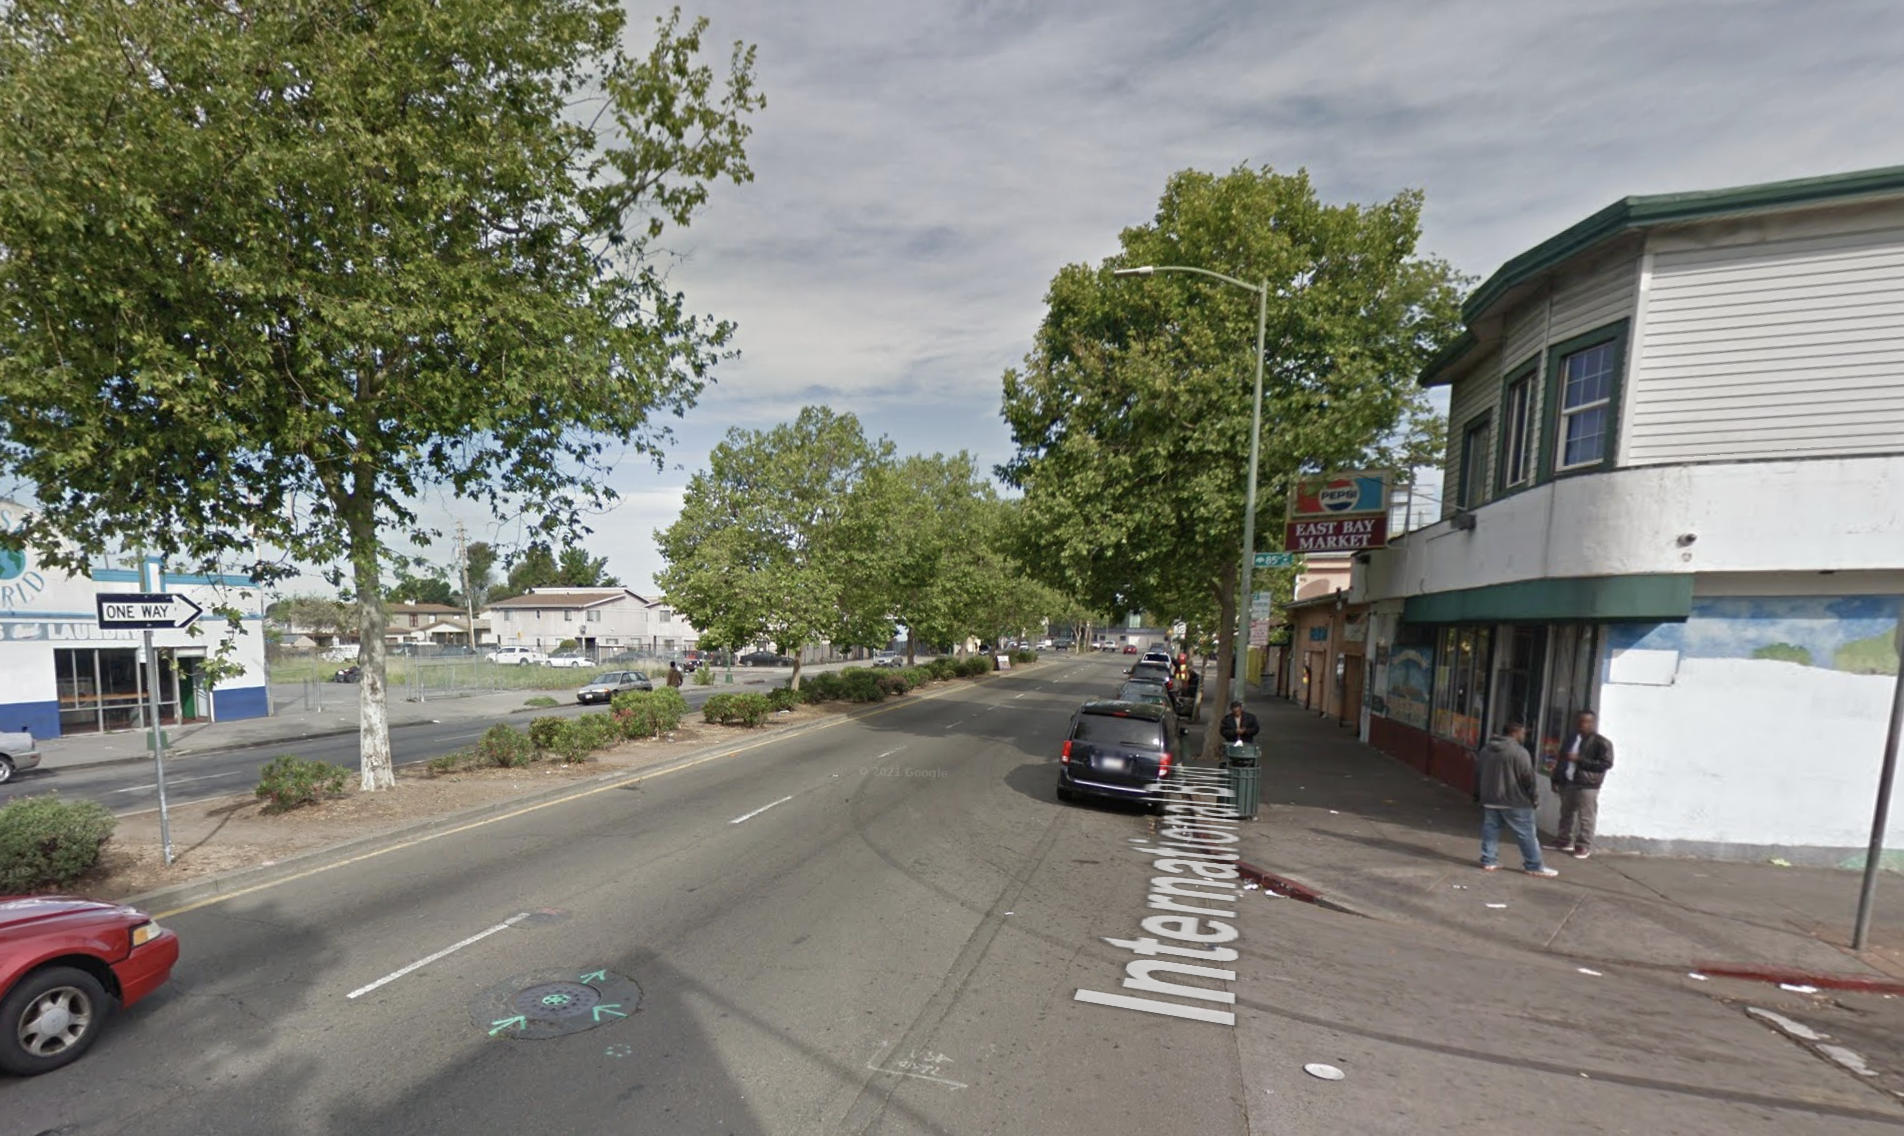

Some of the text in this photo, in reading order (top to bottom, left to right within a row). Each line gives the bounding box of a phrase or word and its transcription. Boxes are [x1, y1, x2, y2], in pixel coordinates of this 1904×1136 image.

[1321, 490, 1358, 500] PEPSI
[1295, 519, 1376, 536] EAST BAY
[1298, 533, 1372, 550] MARKET
[105, 604, 170, 619] ONE WAY
